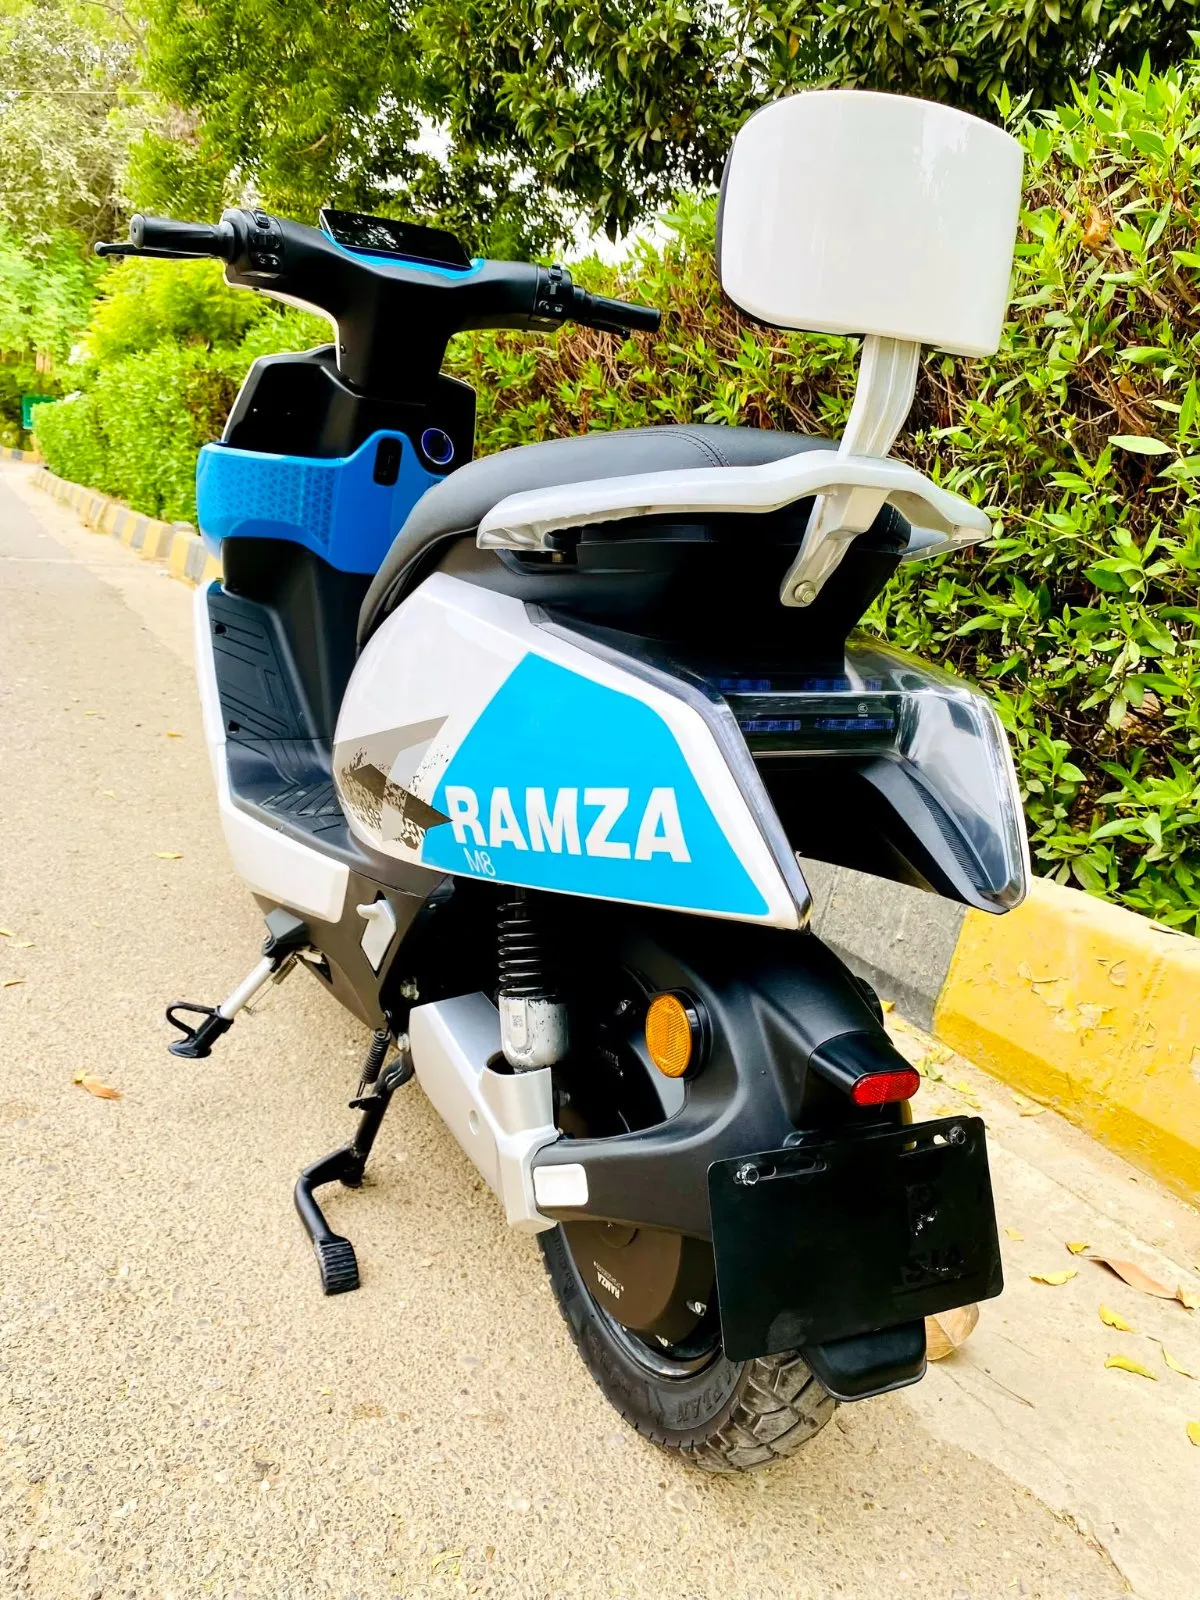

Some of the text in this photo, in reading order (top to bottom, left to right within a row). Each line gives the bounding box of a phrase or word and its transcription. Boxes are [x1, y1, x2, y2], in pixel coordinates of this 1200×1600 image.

[445, 785, 692, 863] RAMZA
[463, 847, 496, 877] M8
[597, 1271, 620, 1299] RAMZA
